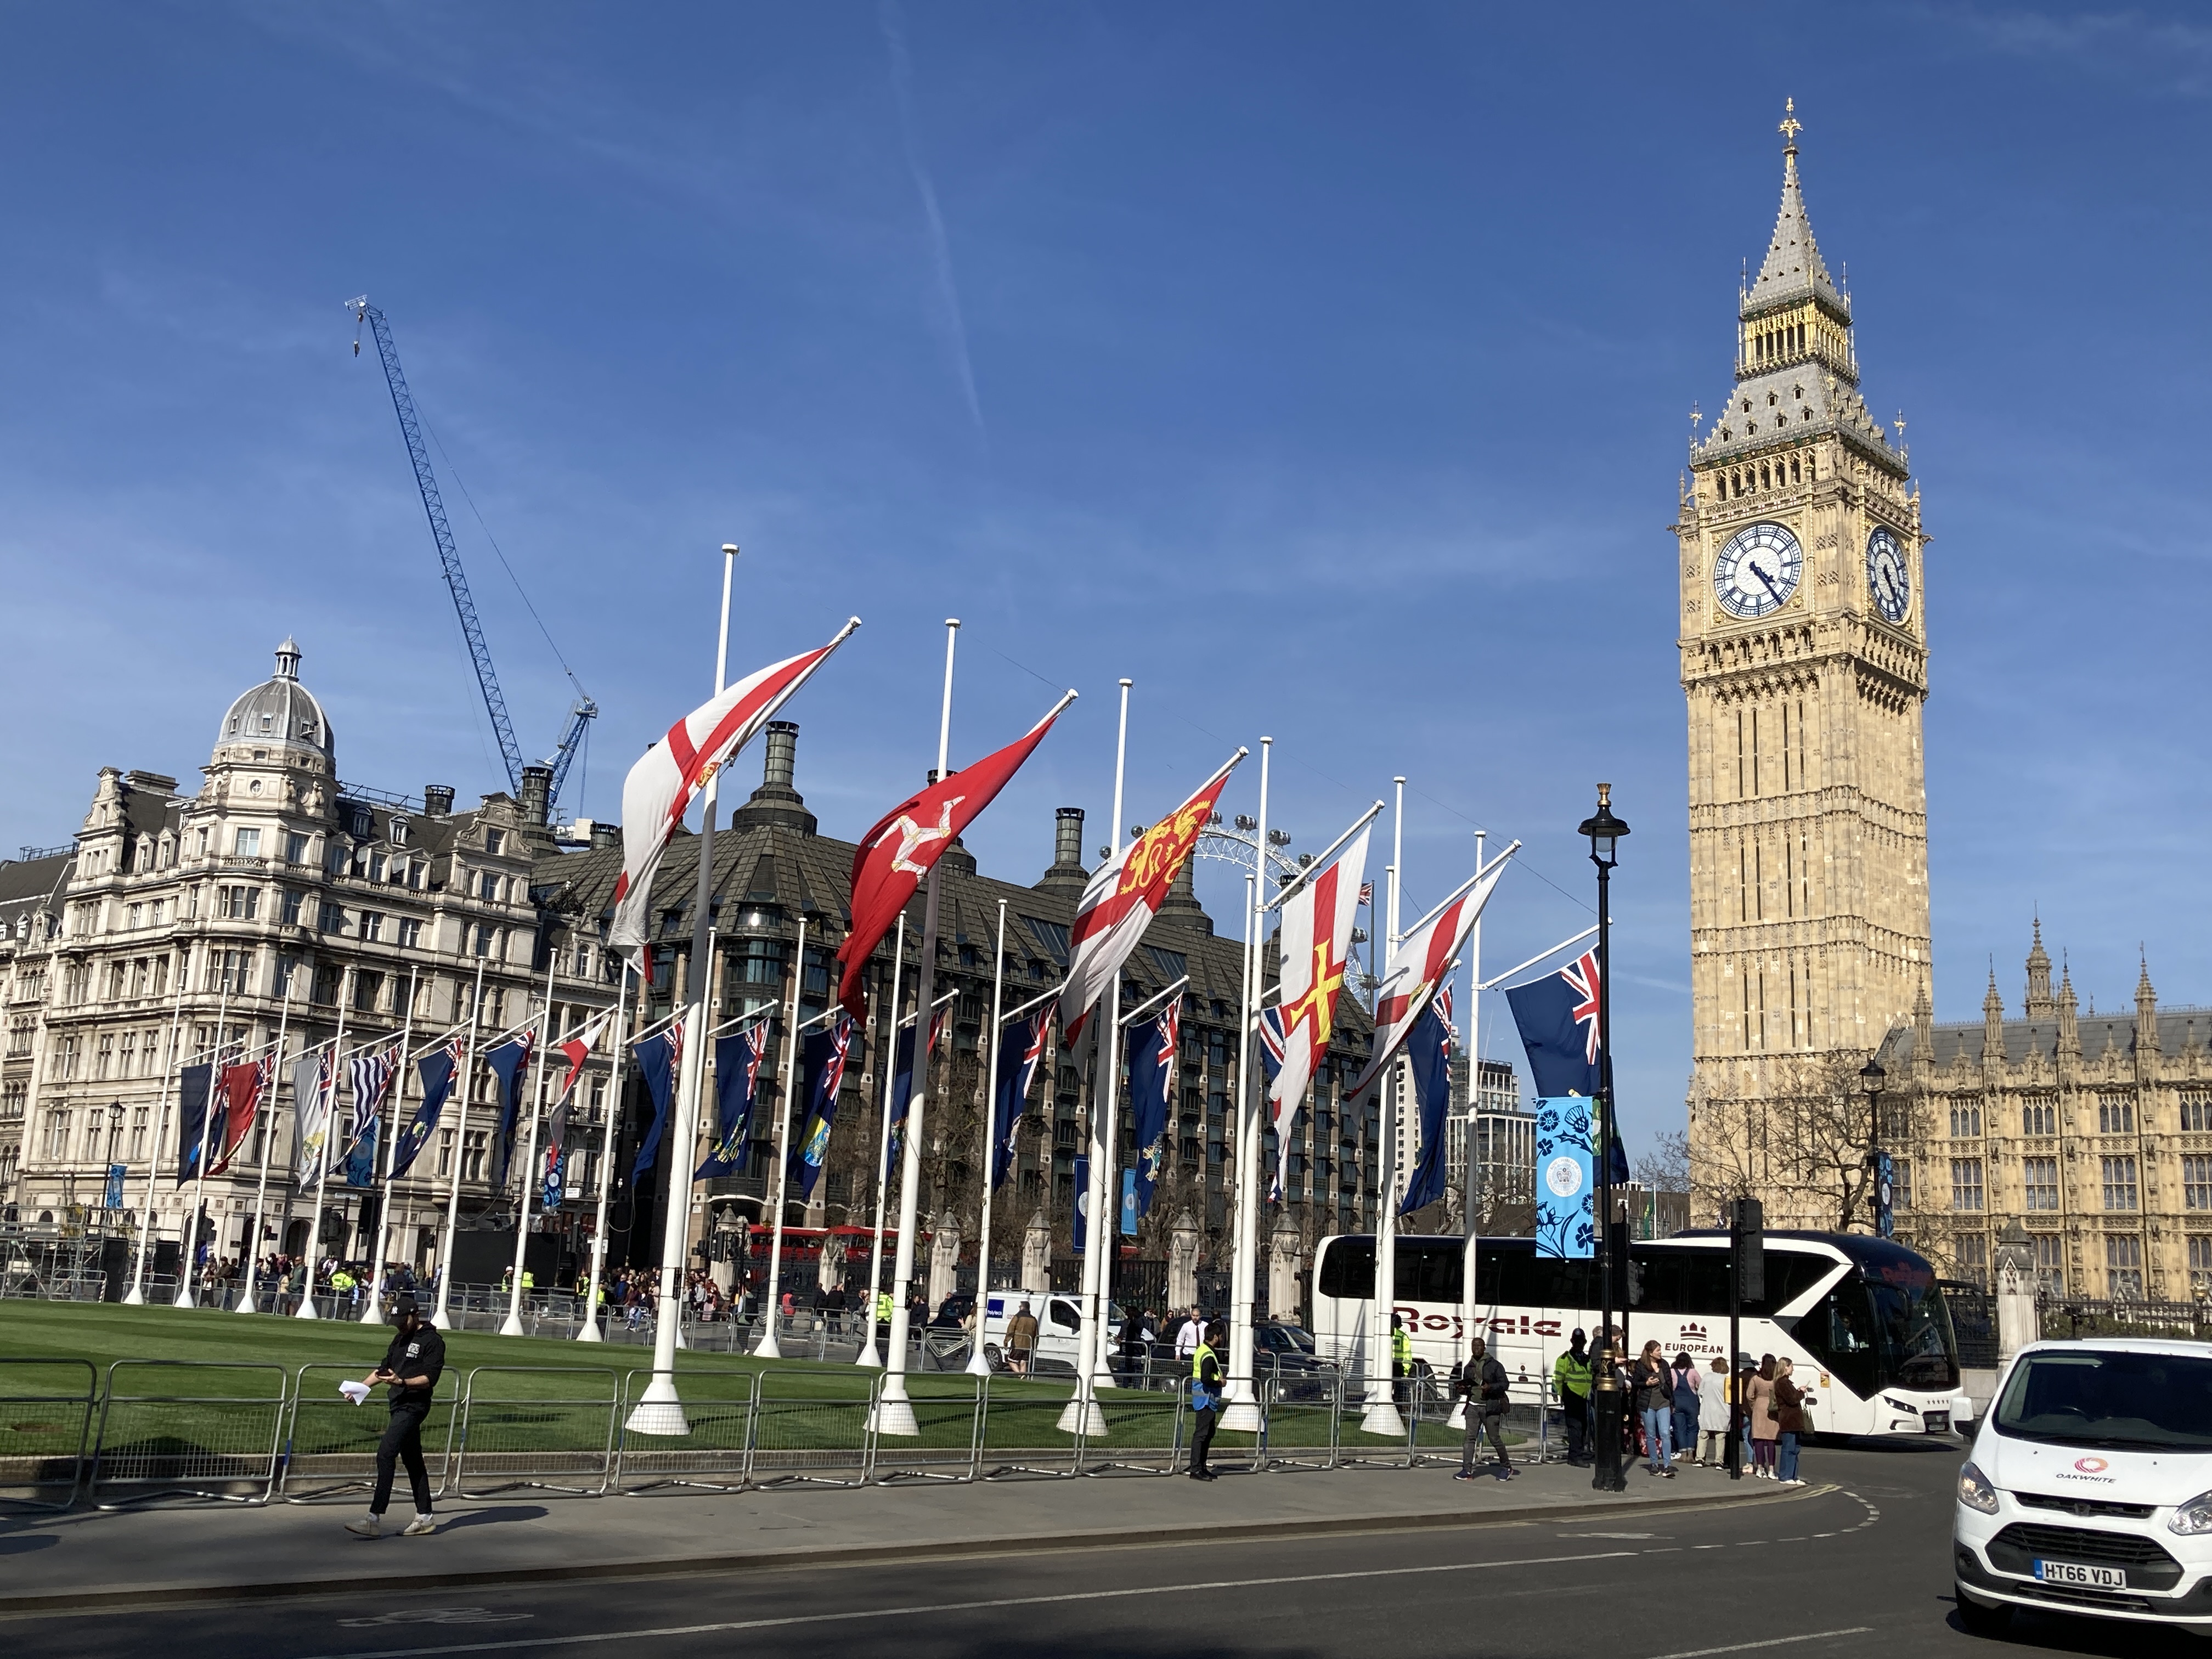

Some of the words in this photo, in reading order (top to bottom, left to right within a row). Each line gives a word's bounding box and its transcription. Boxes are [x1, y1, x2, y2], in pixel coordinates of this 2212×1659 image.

[1665, 1343, 1723, 1353] EUROPEAN
[2056, 1473, 2117, 1484] OAKWHITE
[2045, 1563, 2087, 1582] HT66
[2092, 1567, 2123, 1586] VDJ
